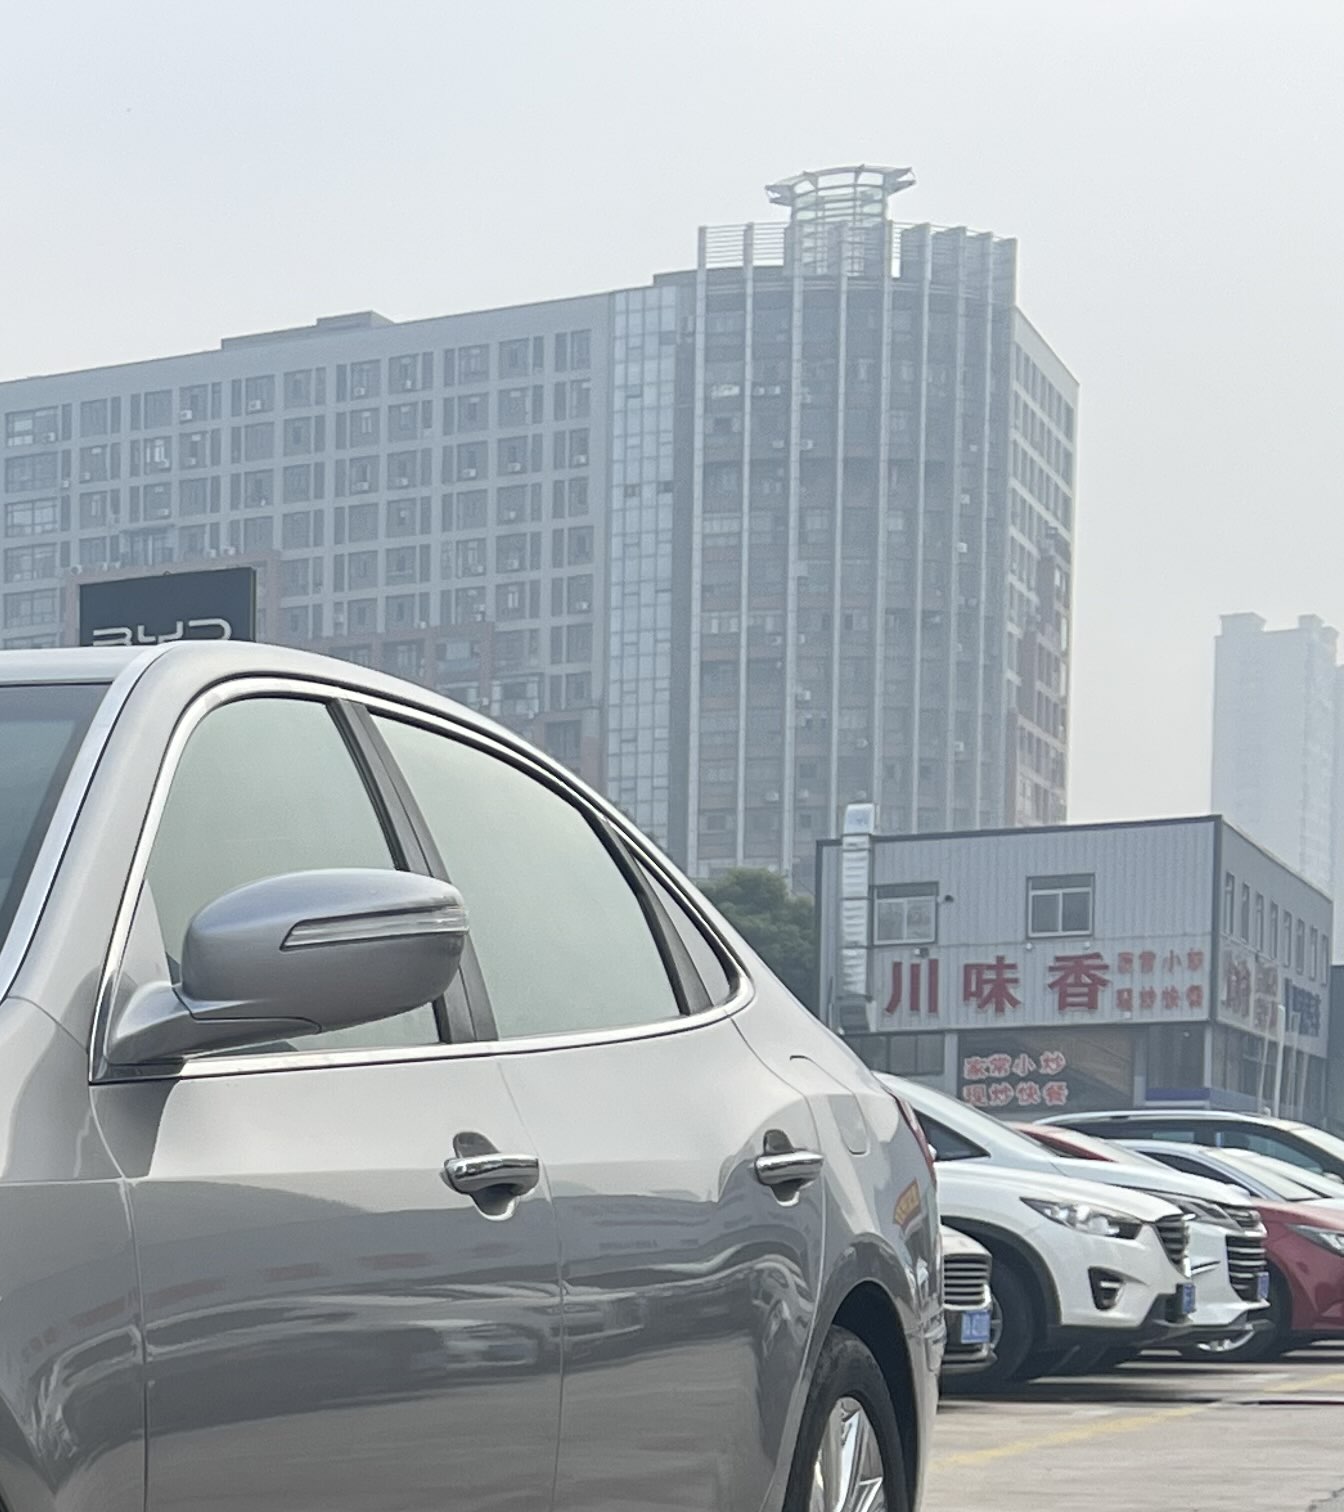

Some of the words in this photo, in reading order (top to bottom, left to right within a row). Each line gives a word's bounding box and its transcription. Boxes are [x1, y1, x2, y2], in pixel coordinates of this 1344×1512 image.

[885, 952, 1111, 1016] 川味香
[963, 1051, 1067, 1081] 家常小炒
